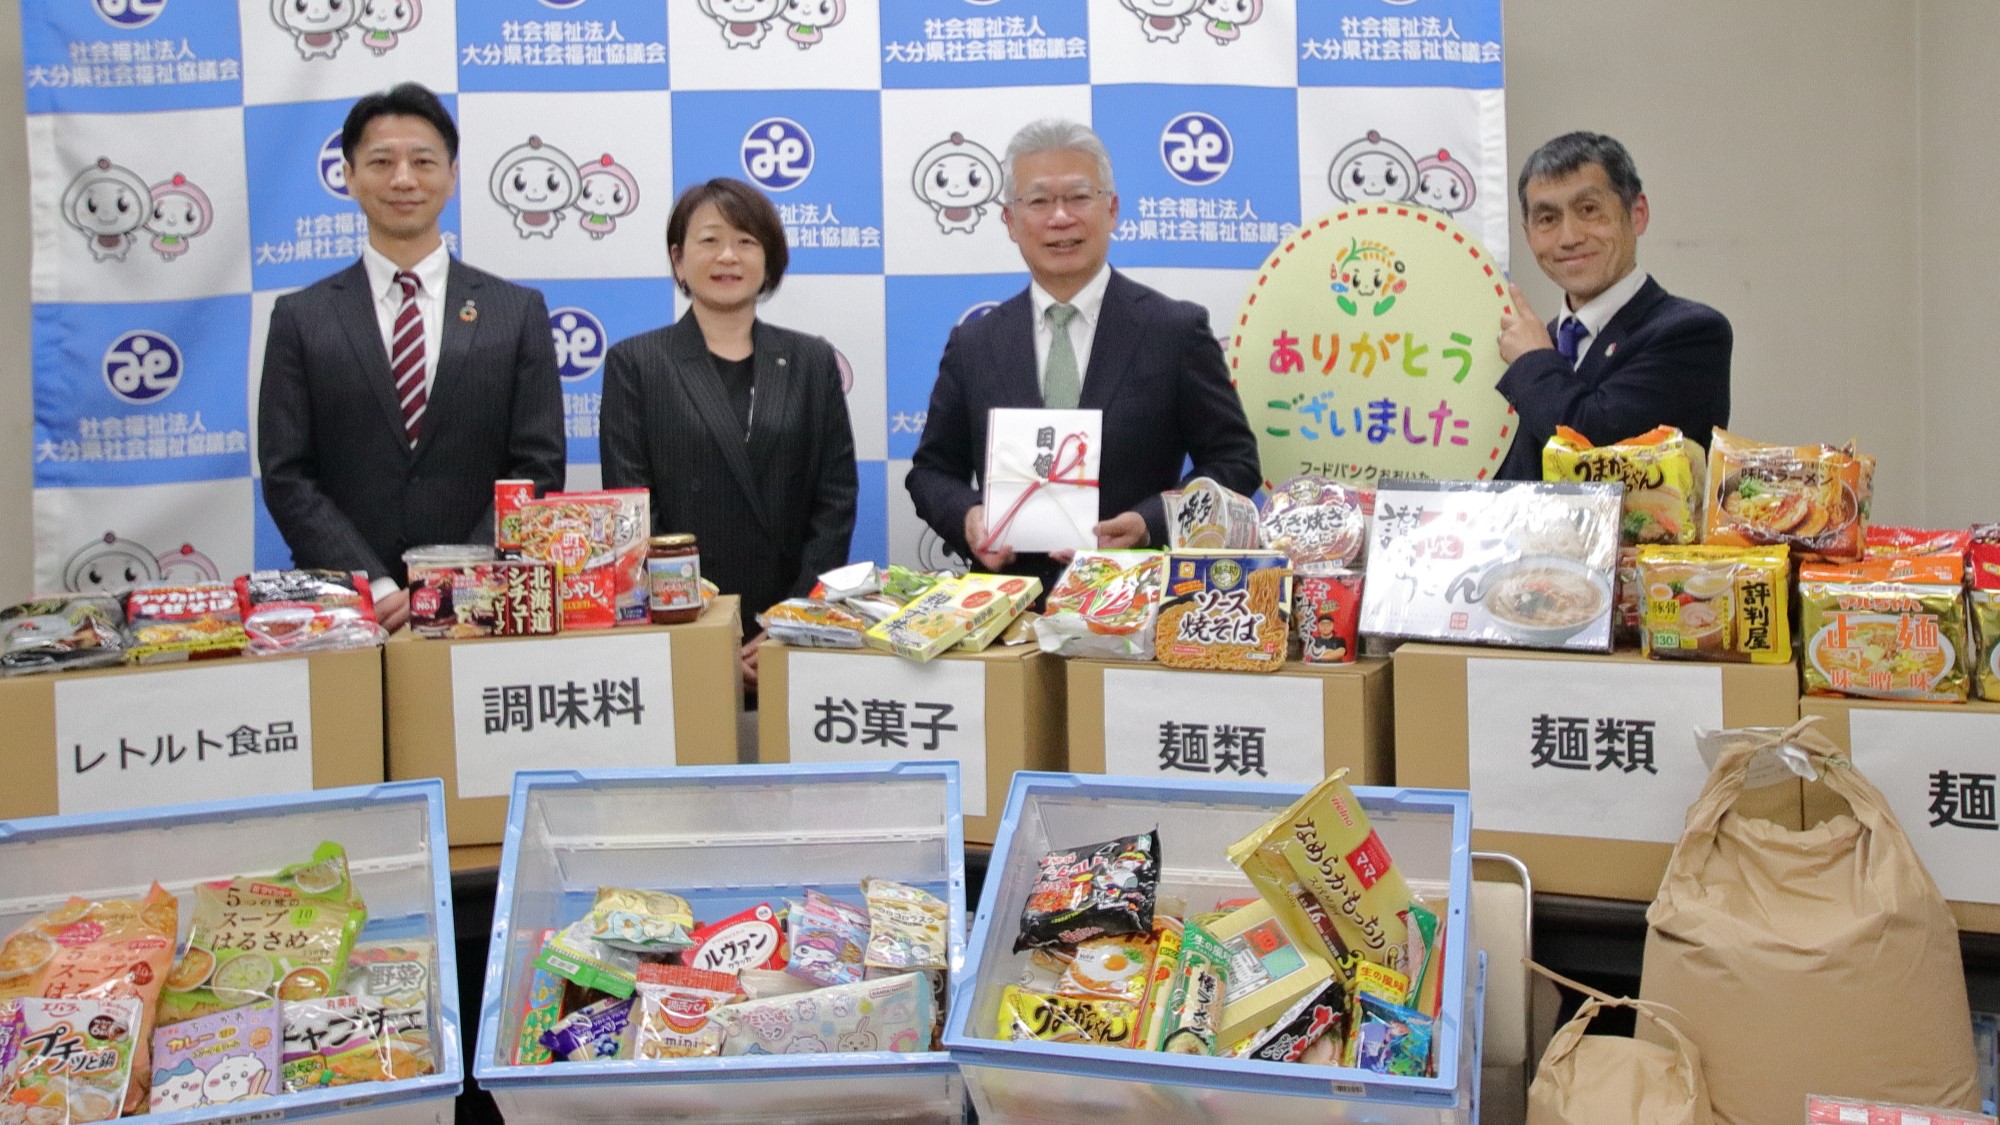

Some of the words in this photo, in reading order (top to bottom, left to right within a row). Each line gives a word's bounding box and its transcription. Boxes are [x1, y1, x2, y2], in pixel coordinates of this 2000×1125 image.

[502, 20, 625, 42] 社会福祉法人
[924, 15, 1046, 39] 社会福祉法人
[1341, 16, 1460, 40] 社会福祉法人
[69, 37, 197, 64] 社会福祉法人
[462, 42, 666, 66] 大分県社会福祉協議会
[885, 37, 1087, 63] 大分県社会福祉協議会
[1302, 38, 1501, 64] 大分県社会福祉協議会
[28, 58, 240, 88] 大分県社会福祉協議会
[1139, 197, 1258, 220] 社会福祉法人
[1269, 330, 1473, 384] ありがとう
[79, 411, 206, 438] 社会福祉法人
[1266, 391, 1470, 447] ございました
[36, 430, 246, 462] 大分県社会福祉協議会
[508, 567, 529, 634] シチュー
[531, 566, 552, 634] 北海道
[1196, 590, 1249, 616] ソース
[1180, 614, 1264, 642] 焼そば
[1741, 580, 1771, 649] 評判屋
[483, 677, 645, 735] 調味料
[814, 697, 958, 750] お菓子
[75, 720, 298, 774] レトルト食品
[1158, 721, 1268, 777] 麺類
[1531, 713, 1658, 775] 麺類
[1295, 818, 1386, 949] なめらかもっちり
[217, 909, 289, 931] スープ
[211, 930, 309, 952] はるさめ
[704, 932, 768, 971] ルヴァン
[52, 963, 128, 980] スープ
[371, 962, 422, 989] 野菜
[1361, 966, 1405, 991] 生の風味
[21, 1025, 117, 1073] プチッと鍋
[167, 1033, 215, 1056] カレー
[665, 1036, 702, 1050] mini
